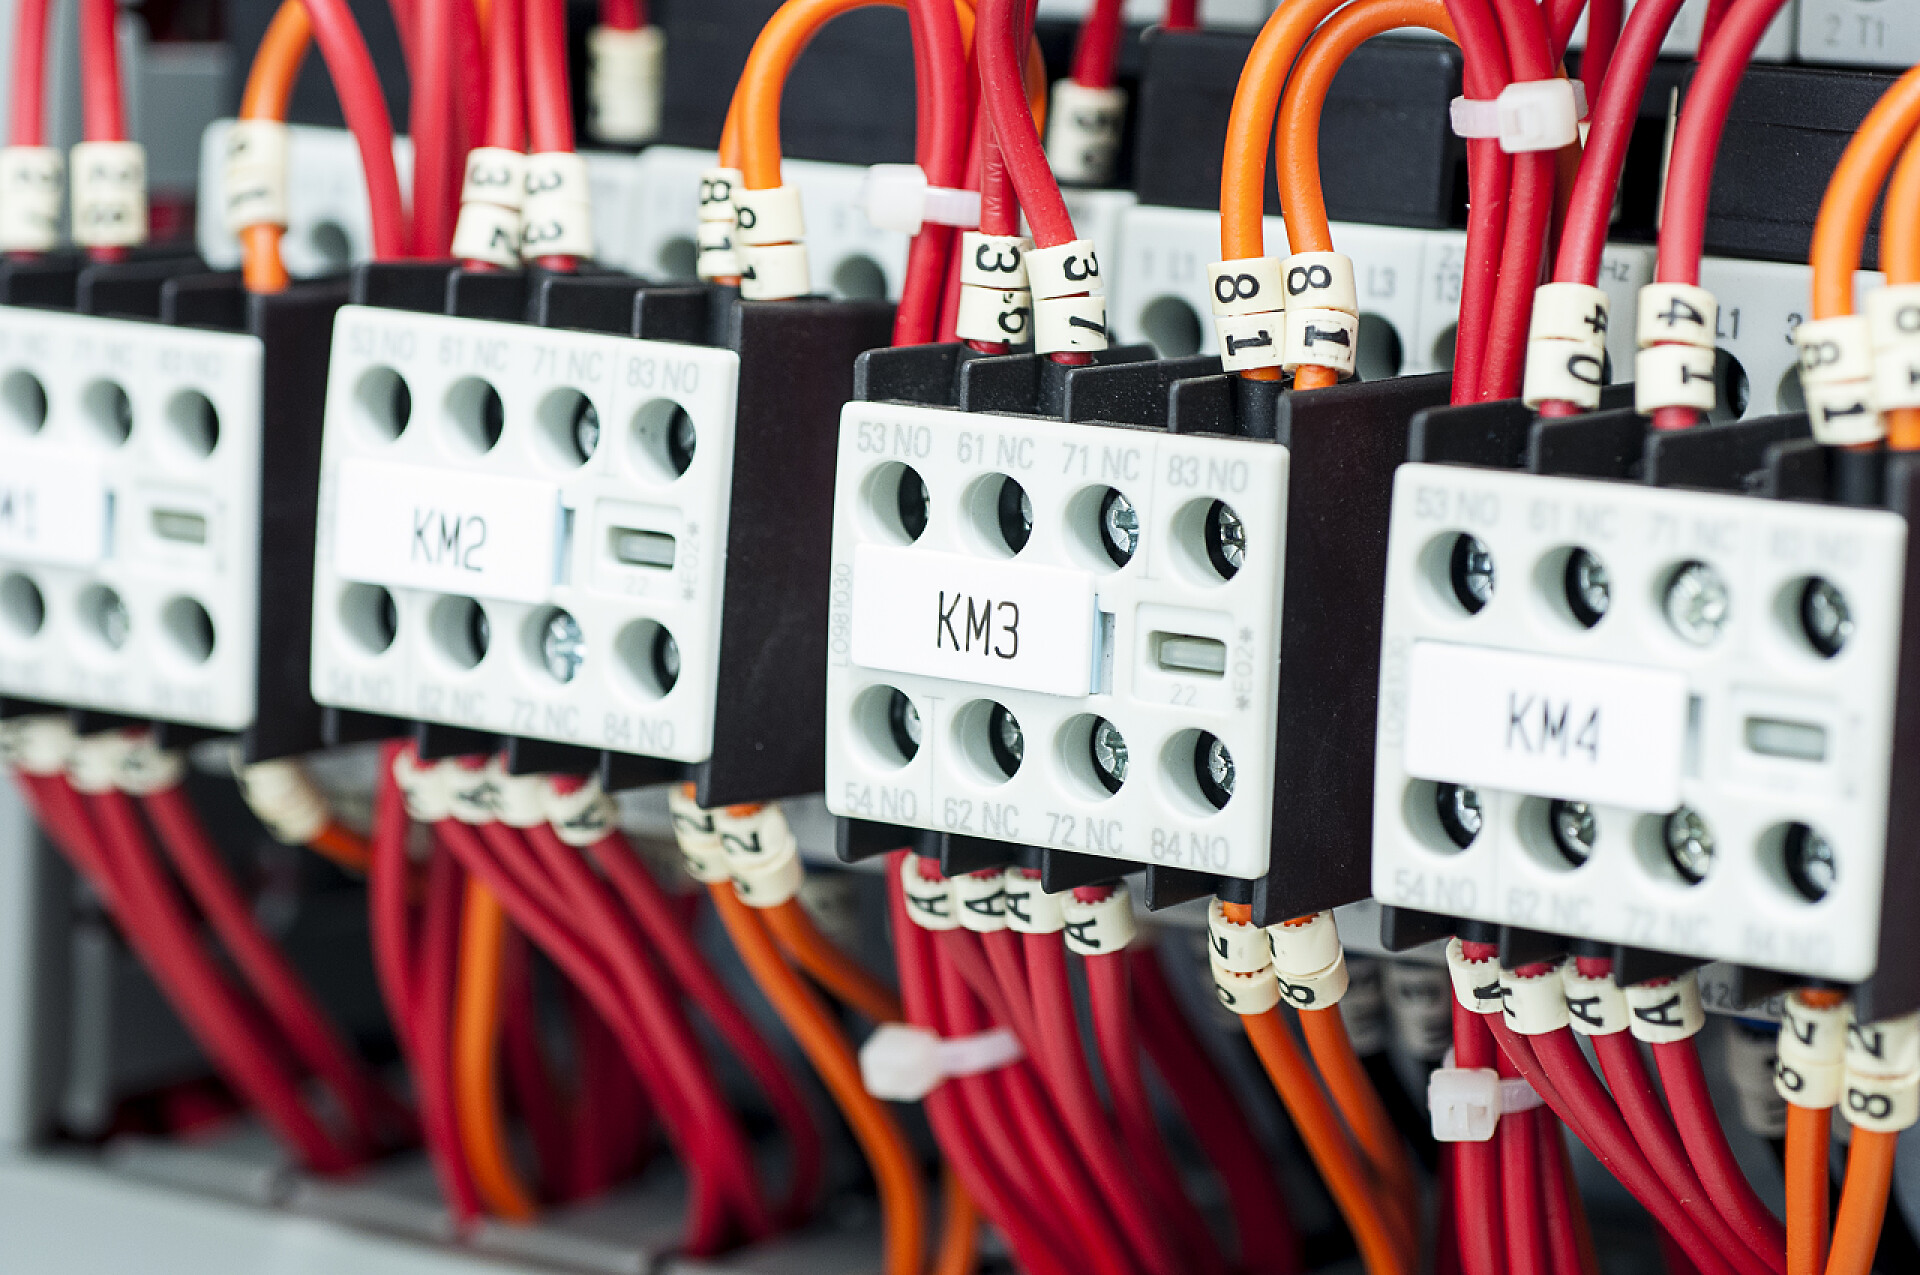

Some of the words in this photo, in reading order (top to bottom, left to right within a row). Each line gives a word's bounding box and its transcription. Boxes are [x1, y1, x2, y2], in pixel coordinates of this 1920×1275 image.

[1214, 272, 1273, 357] 81
[1287, 263, 1351, 348] 81
[626, 356, 656, 389] 83
[664, 359, 700, 395] NO
[857, 421, 887, 454] 53
[893, 424, 932, 459] NO
[957, 430, 985, 465] 61
[996, 434, 1035, 471] NC
[1062, 442, 1091, 476] 71
[1101, 446, 1142, 483] NC
[1167, 453, 1200, 488] 83
[1207, 457, 1250, 494] NO
[411, 506, 488, 574] KM2
[937, 590, 1020, 659] KM3
[1169, 683, 1198, 706] 22
[603, 712, 632, 744] 84
[639, 718, 676, 753] NO
[1505, 690, 1602, 763] KM4
[844, 781, 873, 810] 54
[881, 786, 918, 822] NO
[943, 798, 974, 832] 62
[982, 803, 1020, 839] NC
[1046, 811, 1077, 843] 72
[1085, 815, 1124, 854] NC
[1150, 826, 1183, 862] 84
[1190, 832, 1230, 870] NO
[907, 892, 951, 918] A
[965, 889, 1006, 916] A
[1006, 891, 1031, 924] A
[1064, 917, 1101, 949] A
[1565, 995, 1605, 1027] A
[1634, 992, 1684, 1028] A
